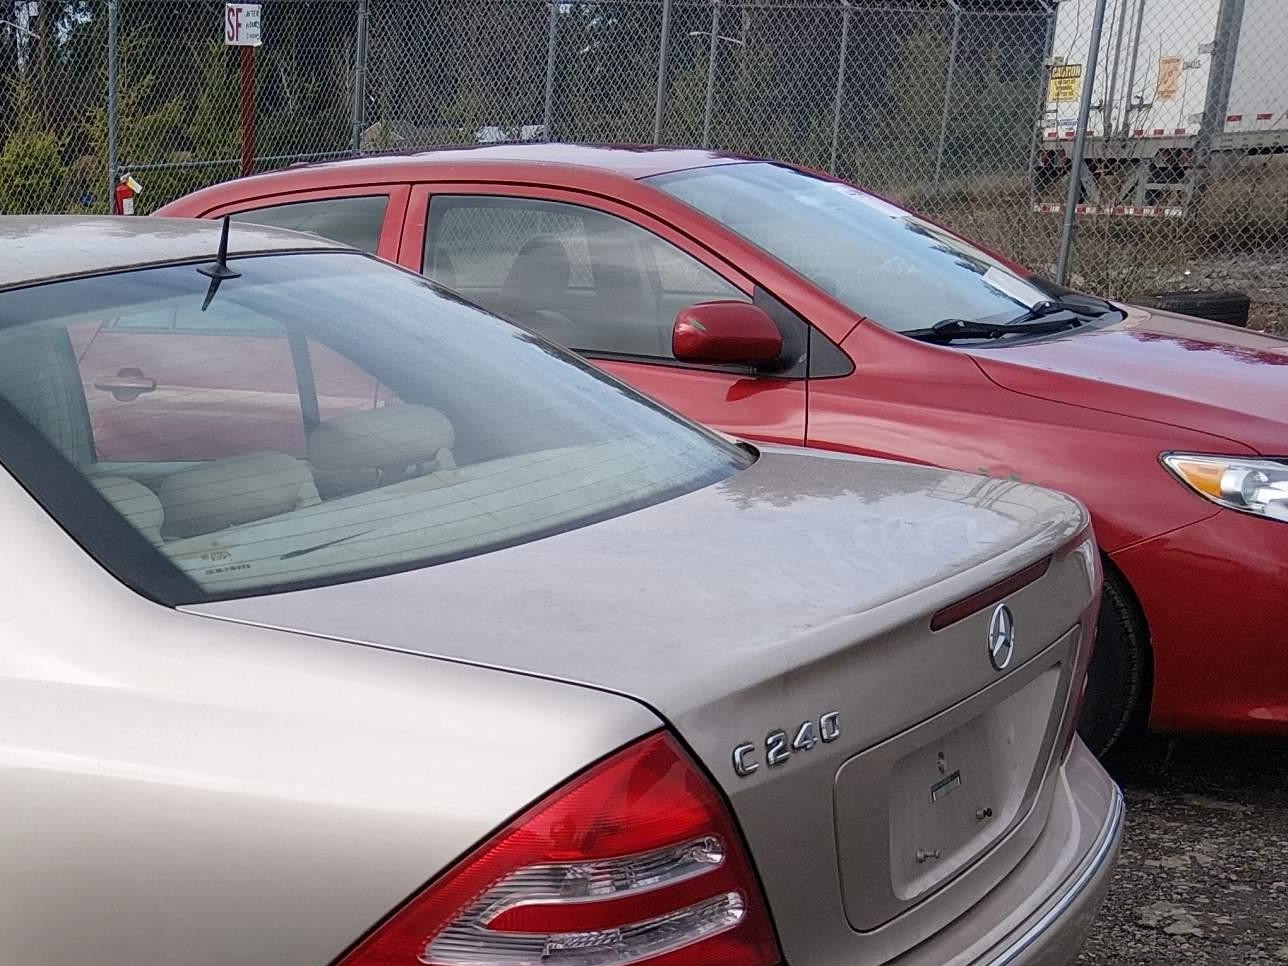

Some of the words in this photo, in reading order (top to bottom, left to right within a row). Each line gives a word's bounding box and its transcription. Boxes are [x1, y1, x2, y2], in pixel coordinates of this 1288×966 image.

[227, 7, 243, 42] SF
[732, 741, 759, 777] C
[766, 709, 841, 768] 240
